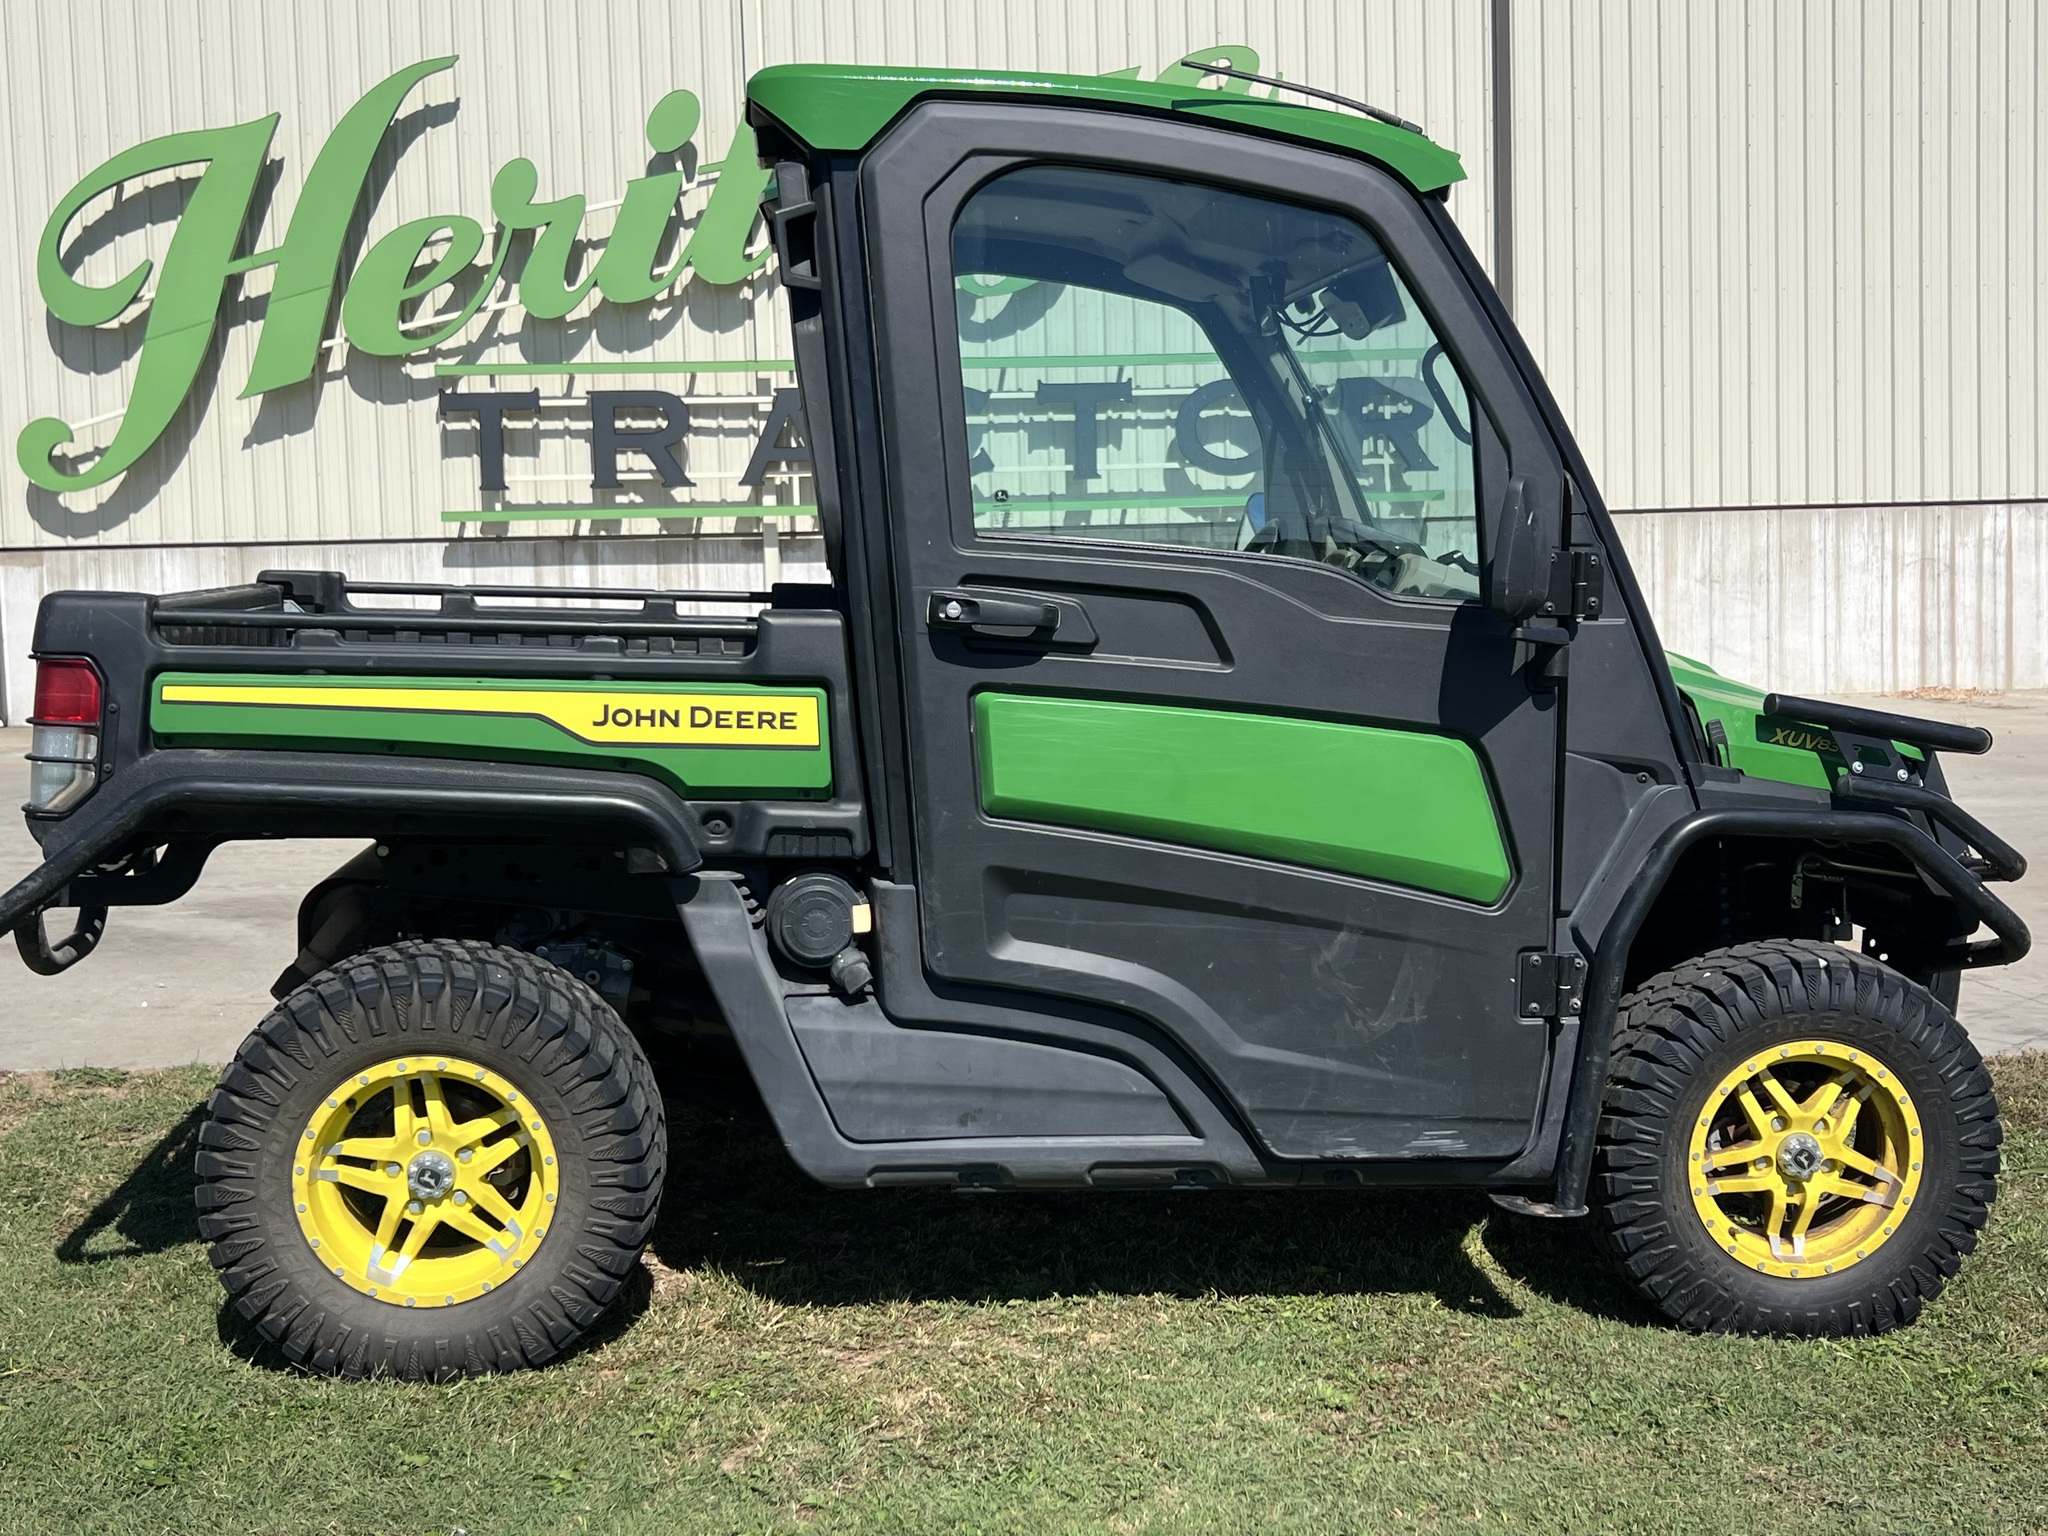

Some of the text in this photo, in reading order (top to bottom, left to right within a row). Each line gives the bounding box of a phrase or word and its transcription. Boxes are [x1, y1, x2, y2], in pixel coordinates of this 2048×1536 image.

[18, 46, 1283, 496] Herit
[438, 376, 1439, 491] TRATOR
[592, 704, 798, 730] JOHN DEERE
